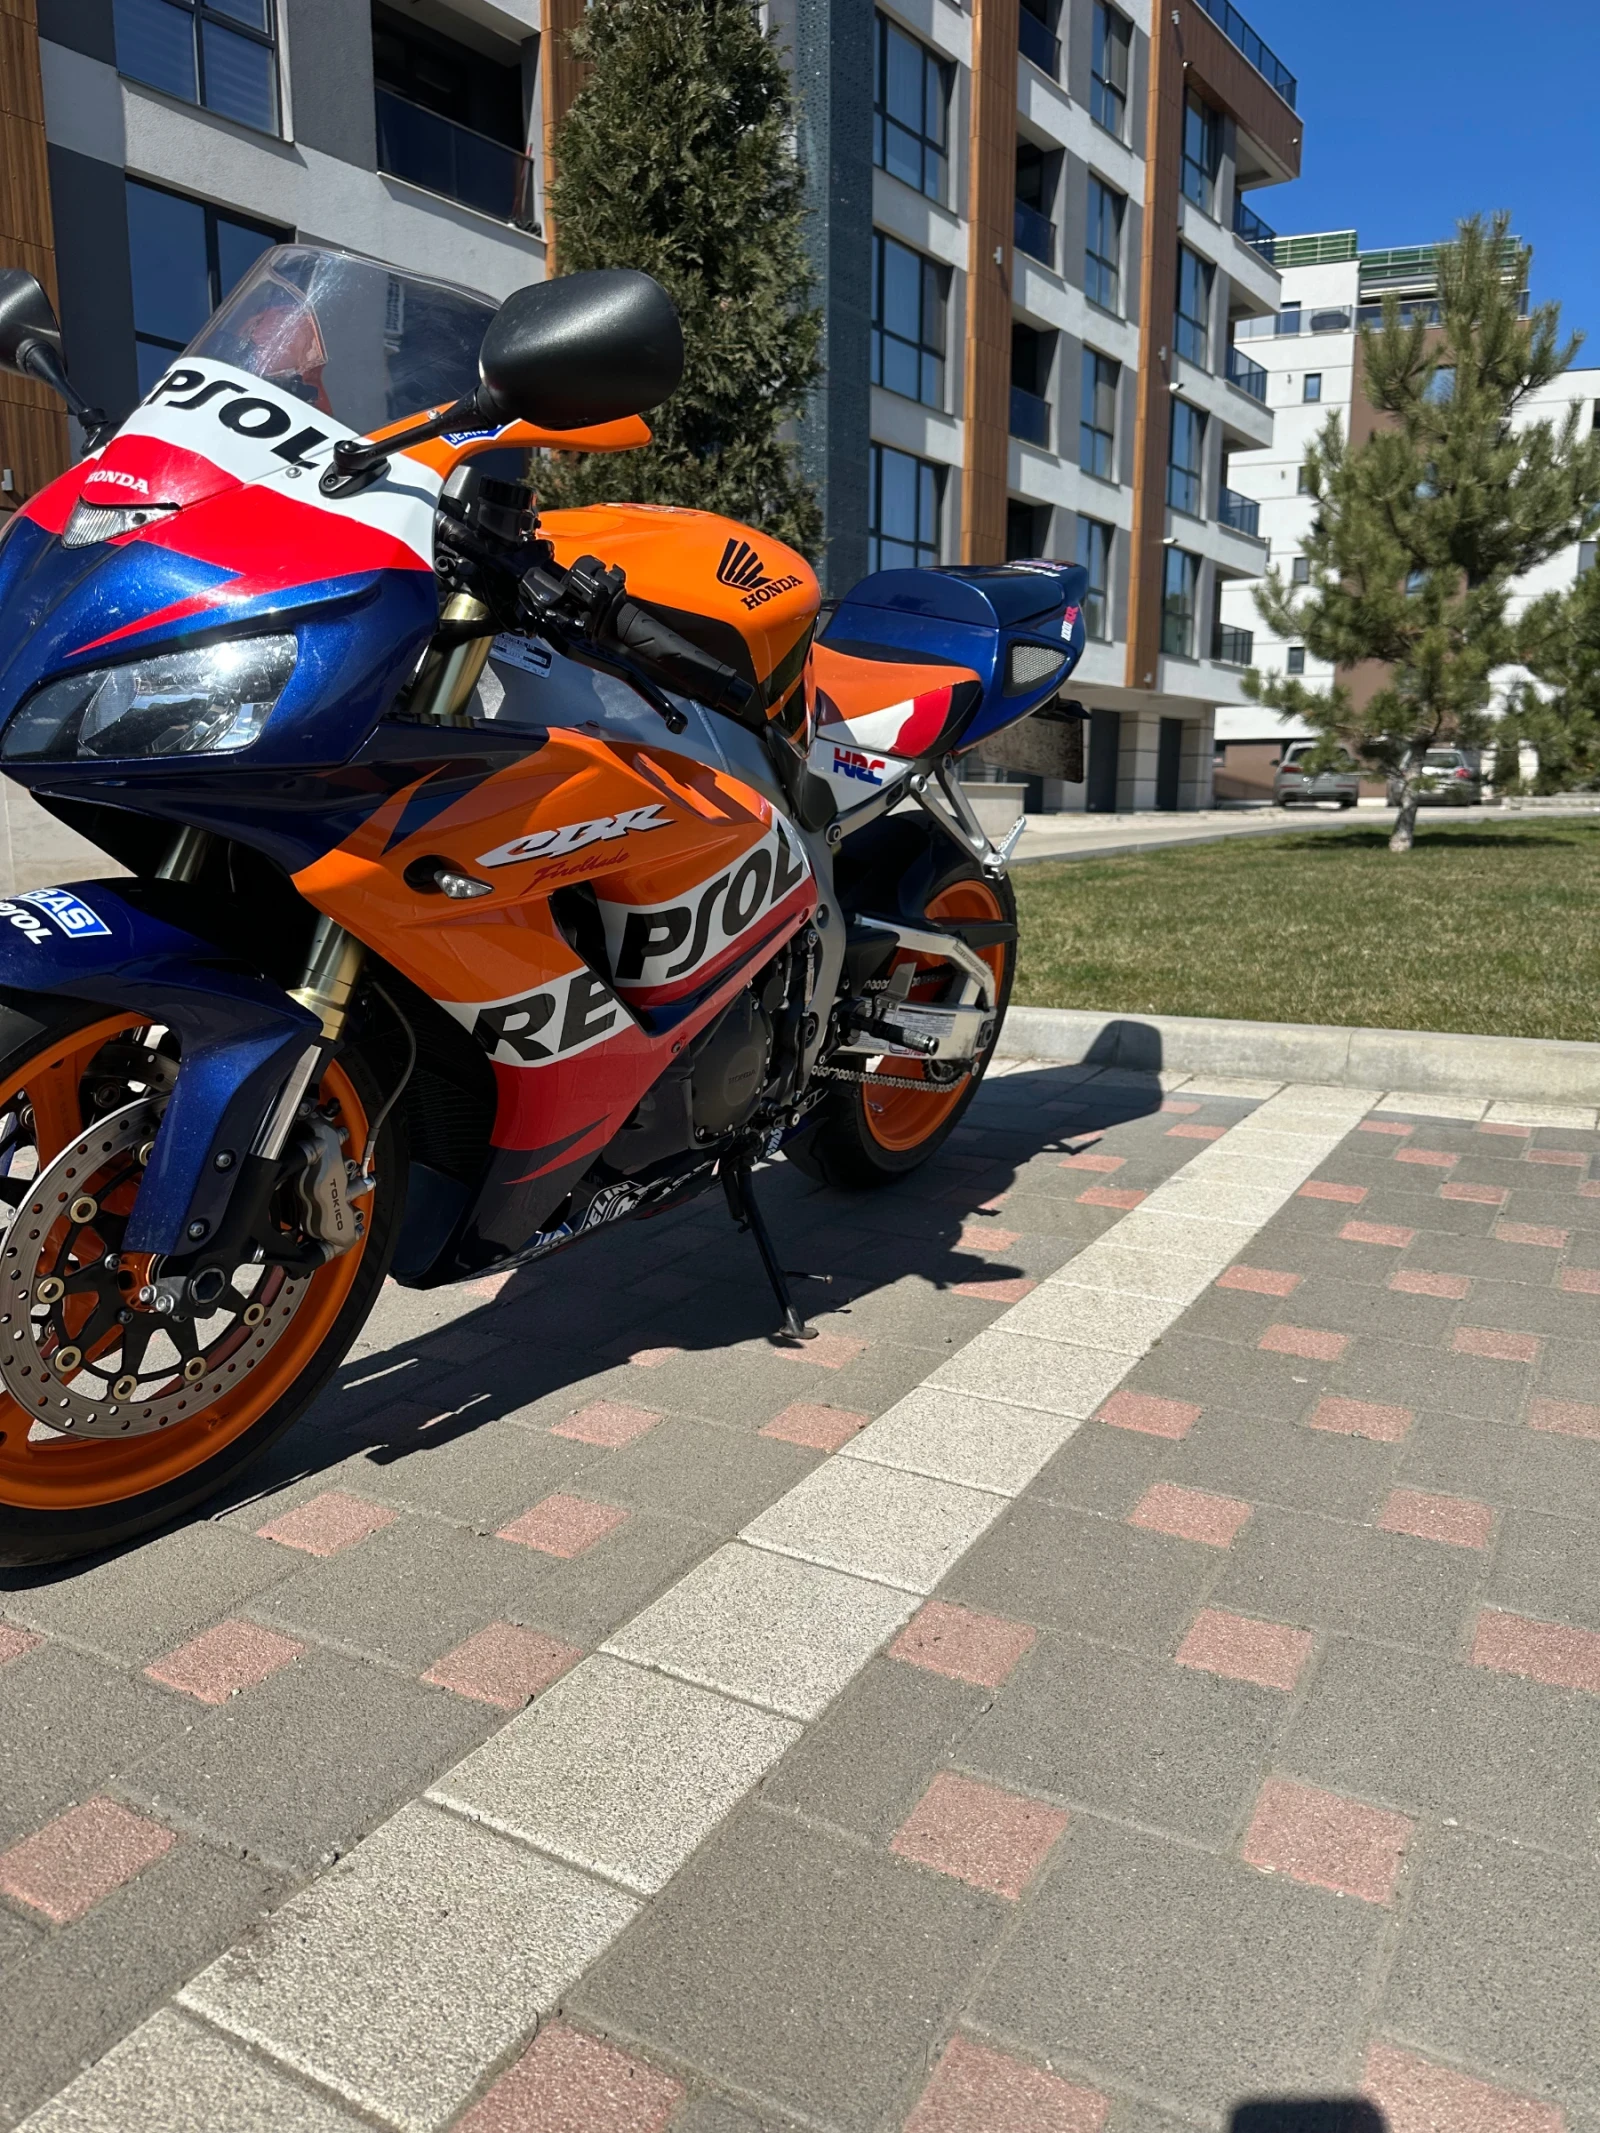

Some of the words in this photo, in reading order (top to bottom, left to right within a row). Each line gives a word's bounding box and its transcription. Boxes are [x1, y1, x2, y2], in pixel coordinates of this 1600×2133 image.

[144, 369, 330, 470] PSOL
[84, 470, 150, 495] HONDA
[740, 575, 804, 611] HONDA
[833, 746, 886, 787] HRC
[474, 803, 679, 869] CBR
[519, 848, 630, 896] Fireblade
[19, 889, 96, 930] GAS
[472, 816, 804, 1062] REPSOL
[330, 1178, 344, 1231] TOKICO
